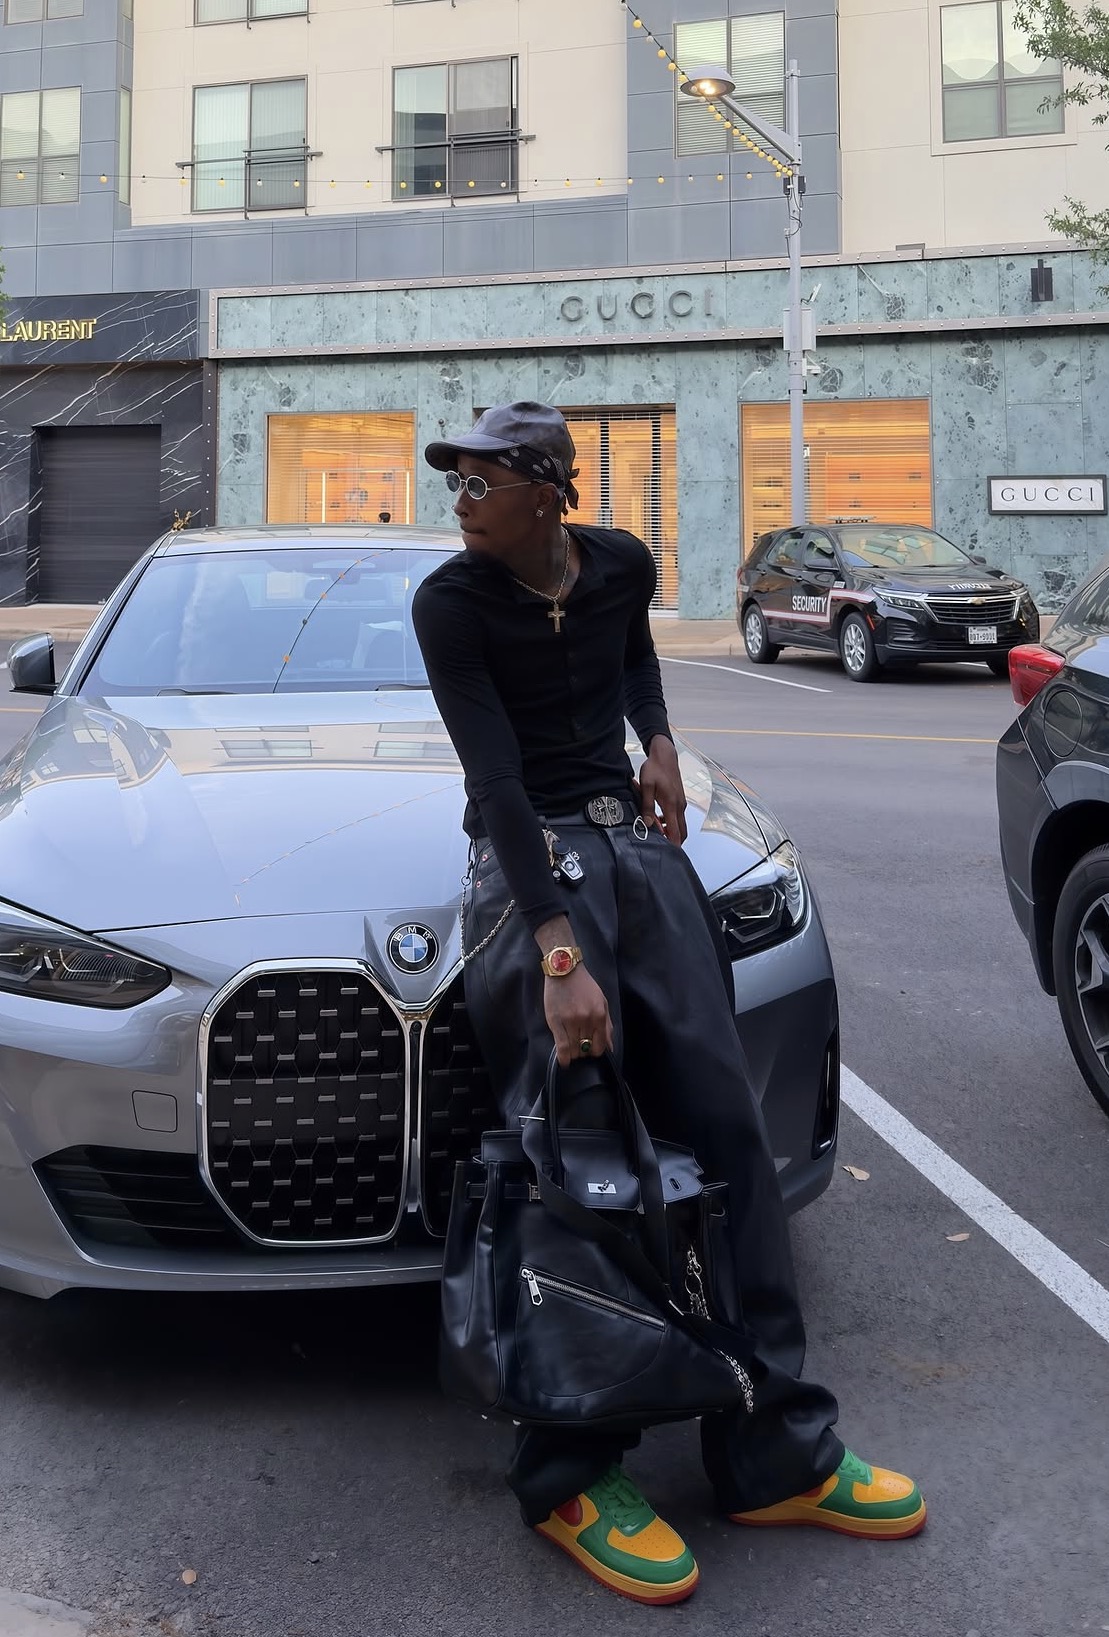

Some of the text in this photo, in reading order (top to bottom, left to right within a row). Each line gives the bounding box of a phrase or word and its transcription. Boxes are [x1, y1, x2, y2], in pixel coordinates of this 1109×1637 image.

[560, 288, 713, 323] GUCCI
[0, 318, 97, 342] LAURENT
[1000, 486, 1095, 502] GUCCI
[792, 595, 827, 613] SECURITY
